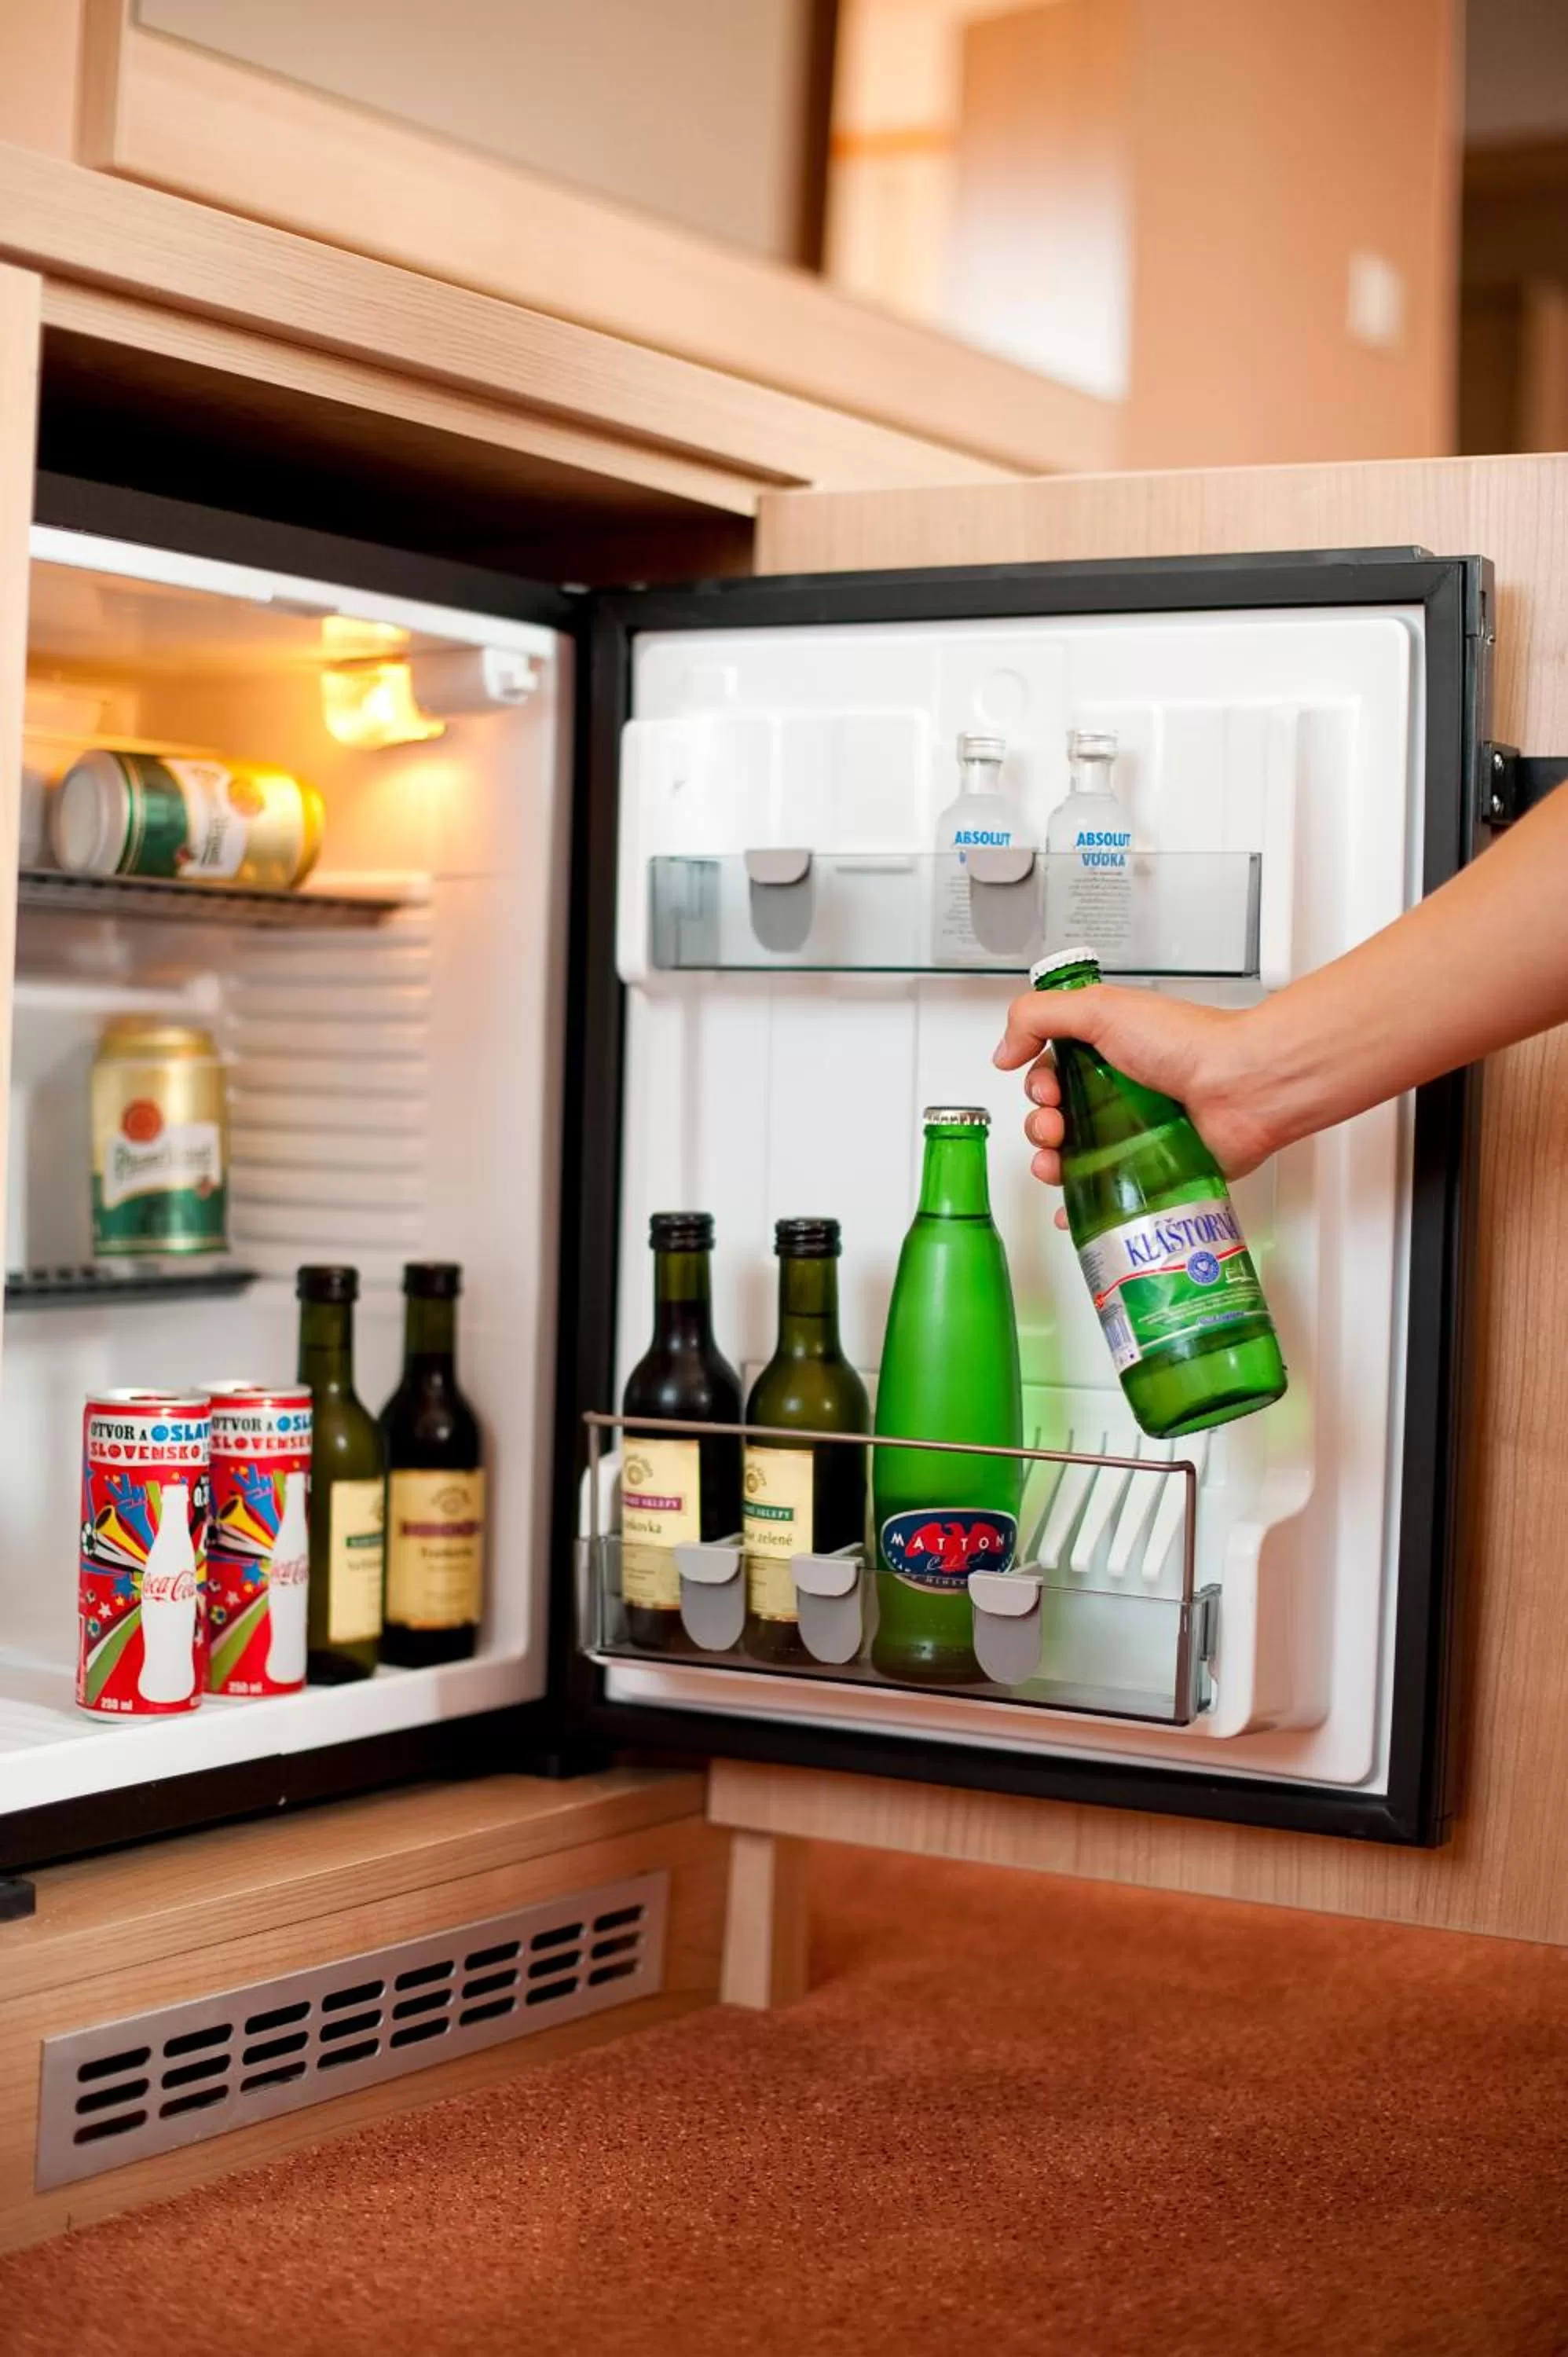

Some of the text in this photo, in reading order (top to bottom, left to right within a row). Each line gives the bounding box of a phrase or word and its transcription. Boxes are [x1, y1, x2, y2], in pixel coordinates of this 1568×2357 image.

[954, 830, 1012, 846] ABSOLUT
[1076, 831, 1131, 847] ABSOLUT
[1082, 852, 1127, 867] VODKA
[90, 1421, 134, 1440] OTVOR
[90, 1441, 201, 1460] SLOVENSKO
[891, 1530, 1013, 1552] MATTONI
